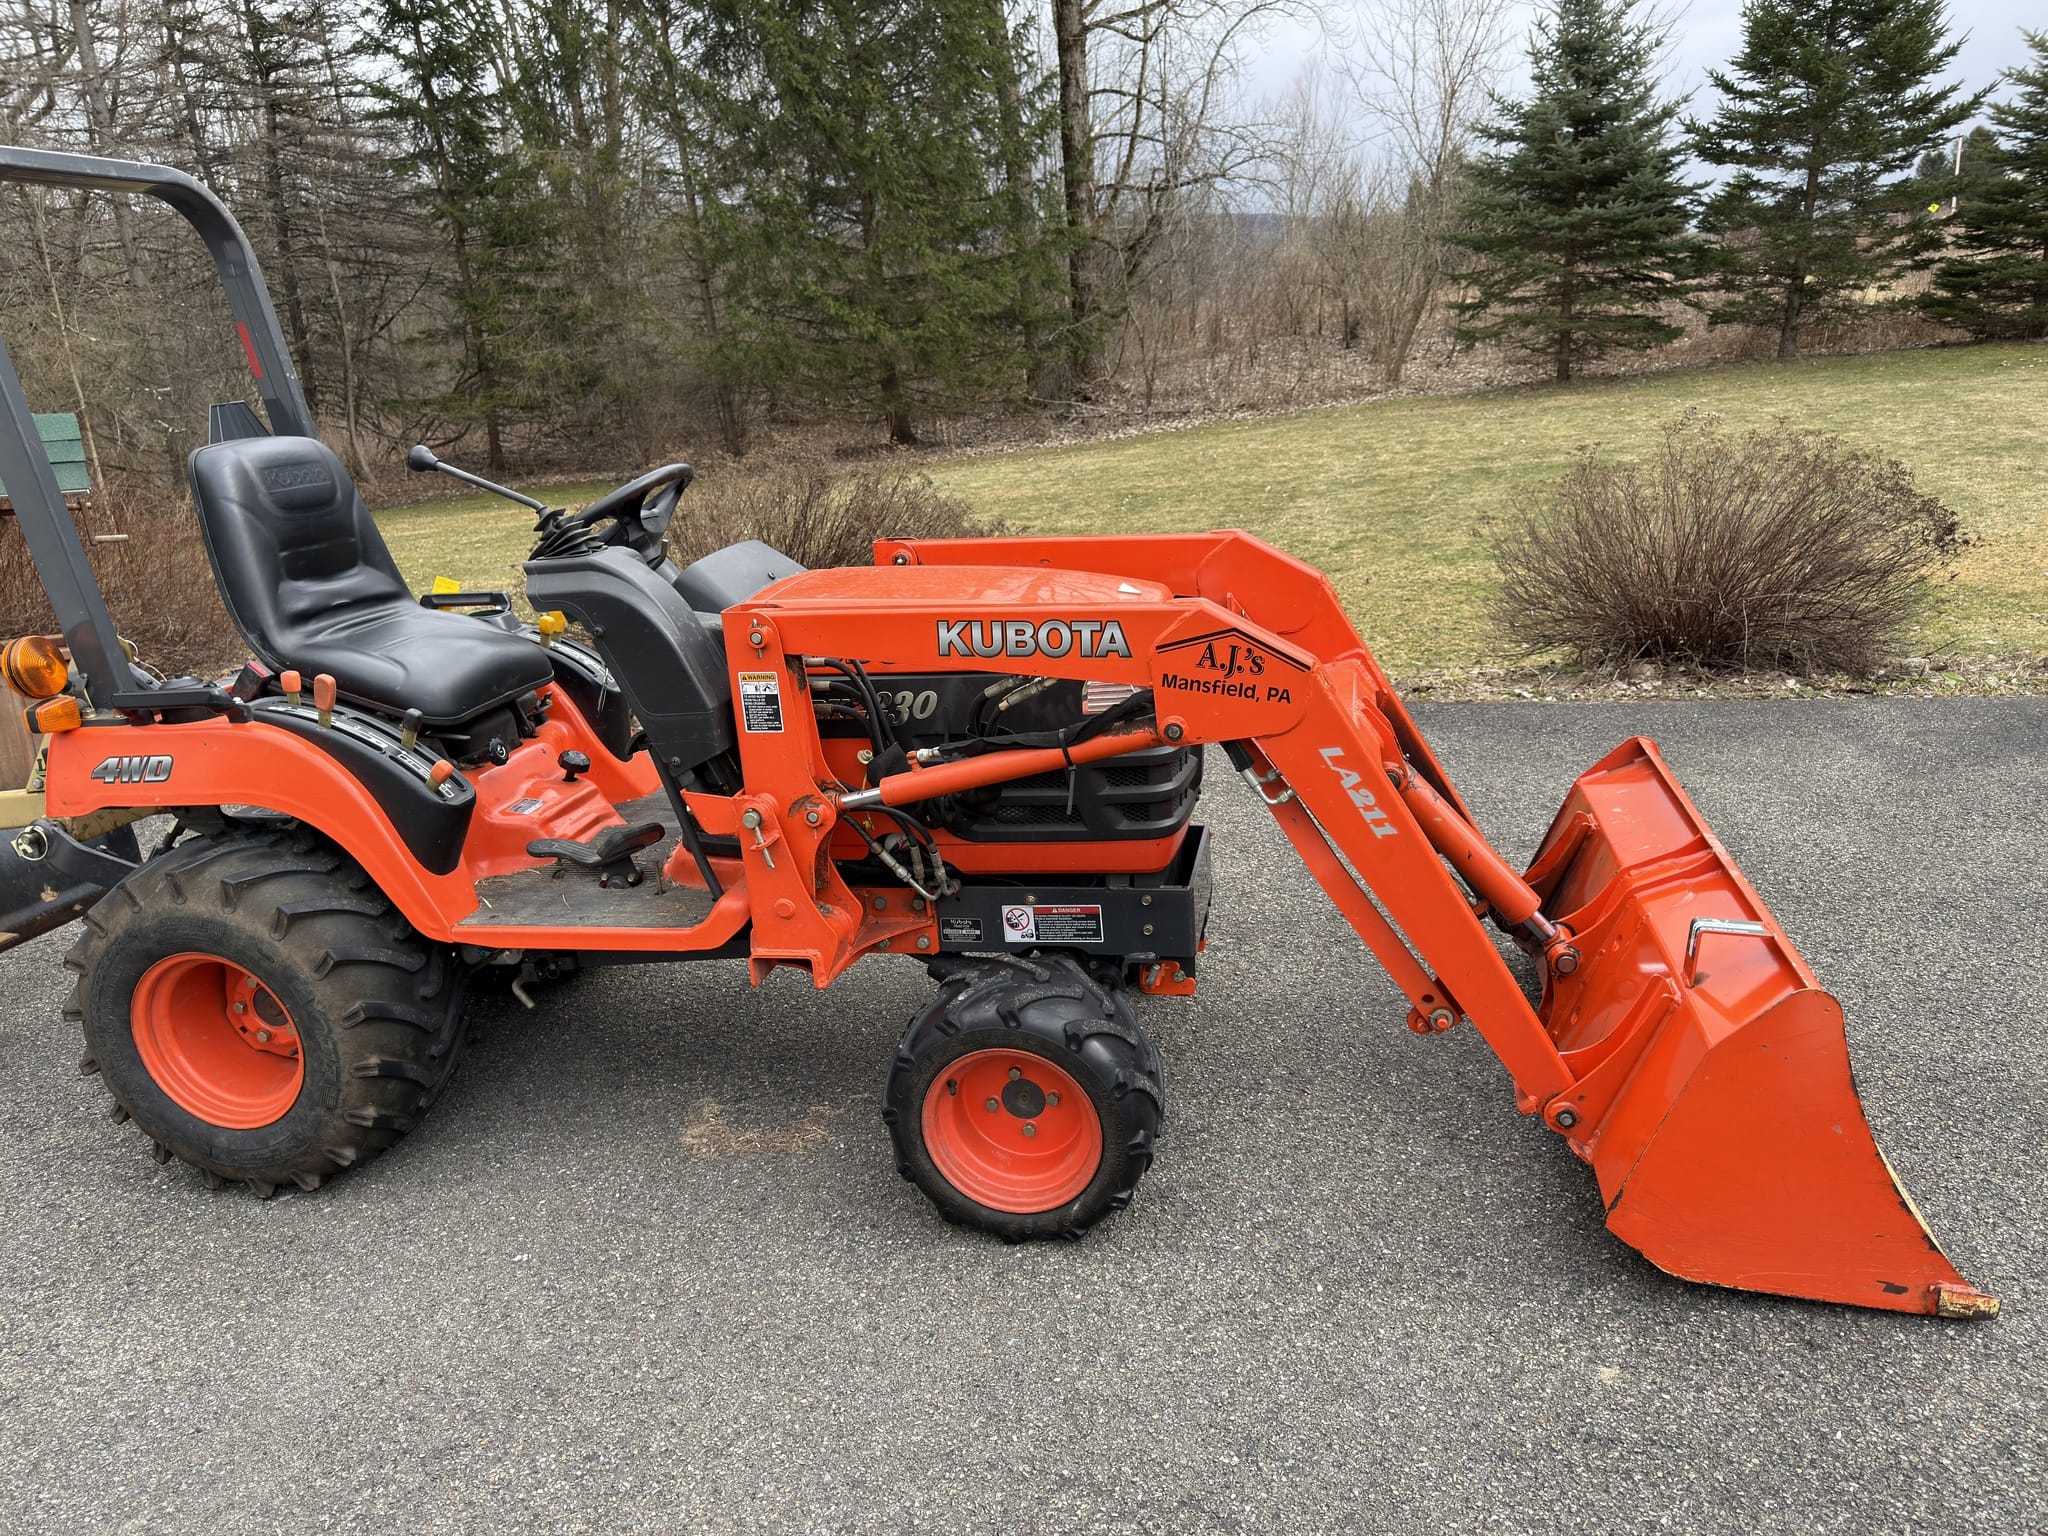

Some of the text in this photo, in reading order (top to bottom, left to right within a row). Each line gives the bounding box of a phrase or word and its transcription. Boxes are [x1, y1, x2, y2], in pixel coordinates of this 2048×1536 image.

[937, 619, 1132, 659] KUBOTA
[1195, 641, 1265, 679] A.J.'s
[1161, 673, 1291, 704] Mansfield, PA
[91, 754, 173, 784] 4WD
[1318, 747, 1398, 839] LA211
